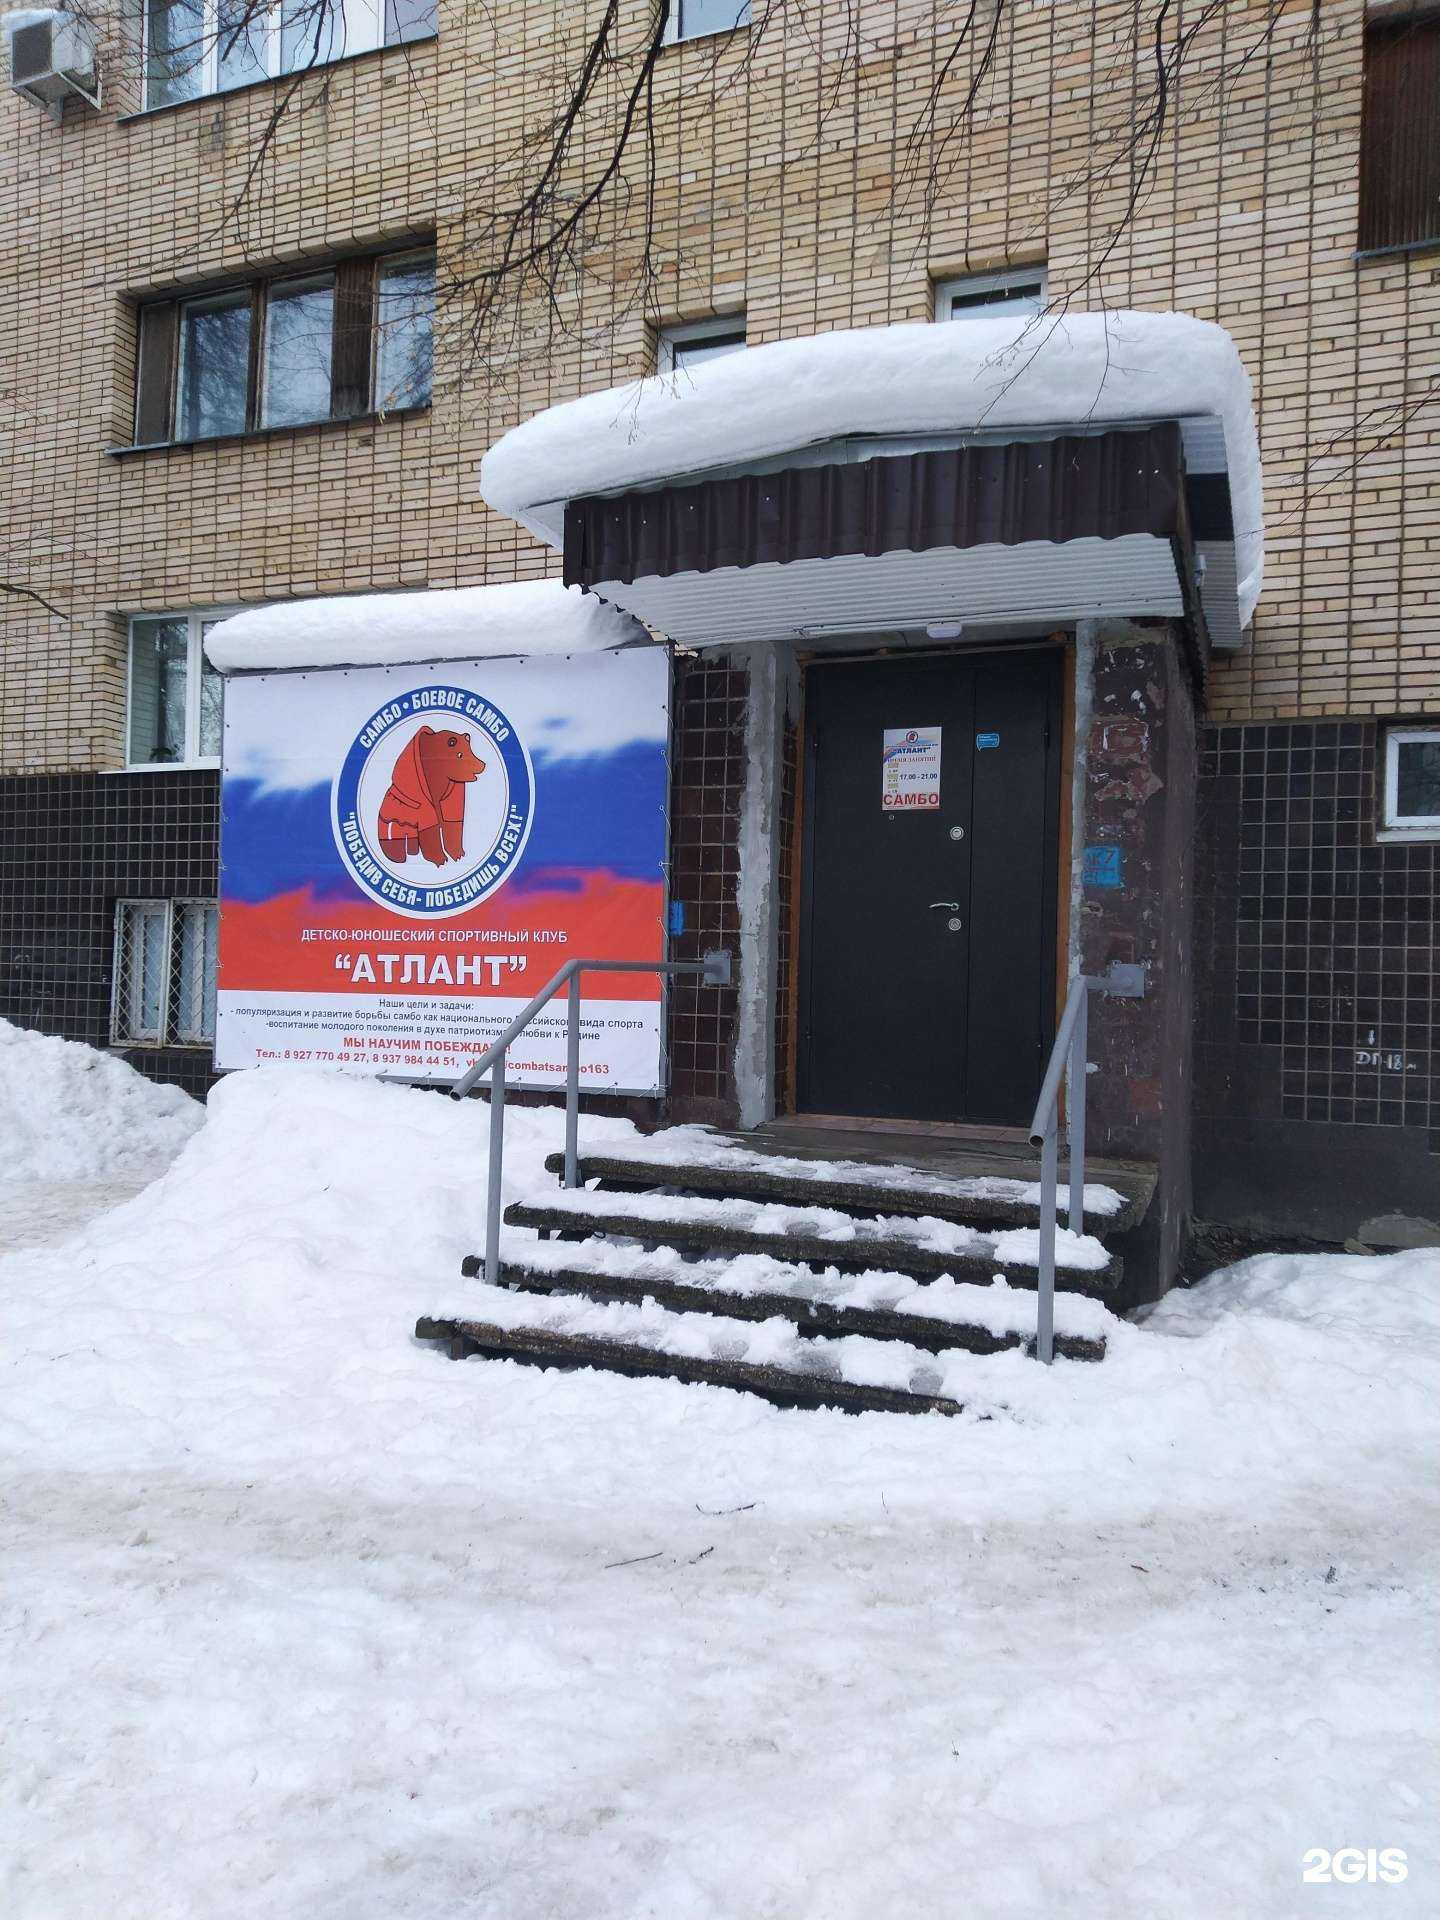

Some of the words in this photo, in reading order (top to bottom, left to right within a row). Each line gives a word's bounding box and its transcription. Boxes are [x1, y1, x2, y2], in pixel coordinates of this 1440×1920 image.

[359, 703, 402, 749] САМБО
[411, 690, 464, 710] БОЕВОЕ
[465, 698, 509, 742] САМБО
[883, 793, 939, 806] САМБО
[342, 812, 383, 884] "ПОБЕДИВ
[425, 862, 500, 908] ПОБЕДИШЬ
[496, 804, 523, 864] ВСЕХ!"
[301, 928, 435, 942] ДЕТСКО-ЮНОШЕСКИЙ
[438, 928, 529, 943] СПОРТИВНЫЙ
[533, 931, 567, 943] КЛУБ
[379, 999, 404, 1008] Наши
[407, 1000, 429, 1009] цели
[439, 1002, 474, 1010] задачи:
[236, 1008, 301, 1018] популяризация
[312, 1010, 353, 1019] развитие
[355, 1010, 391, 1019] борьбы
[393, 1012, 421, 1020] самбо
[440, 1014, 512, 1024] национального
[580, 1019, 605, 1028] вида
[608, 1020, 643, 1029] спорта
[321, 1023, 364, 1031] молодого
[366, 1024, 414, 1032] поколения
[424, 1027, 446, 1035] духе
[343, 1037, 365, 1048] МЫ
[368, 1038, 421, 1050] НАУЧИМ
[424, 1041, 511, 1055] ПОБЕЖДА!
[256, 1049, 281, 1058] Тел.:
[284, 1050, 290, 1059] 8
[293, 1051, 312, 1060] 927
[315, 1052, 334, 1061] 770
[337, 1052, 350, 1062] 49
[353, 1053, 369, 1063] 27,
[372, 1054, 379, 1063] 8
[382, 1054, 401, 1064] 937
[404, 1055, 423, 1065] 984
[426, 1056, 439, 1066] 44
[443, 1056, 460, 1067] 51,
